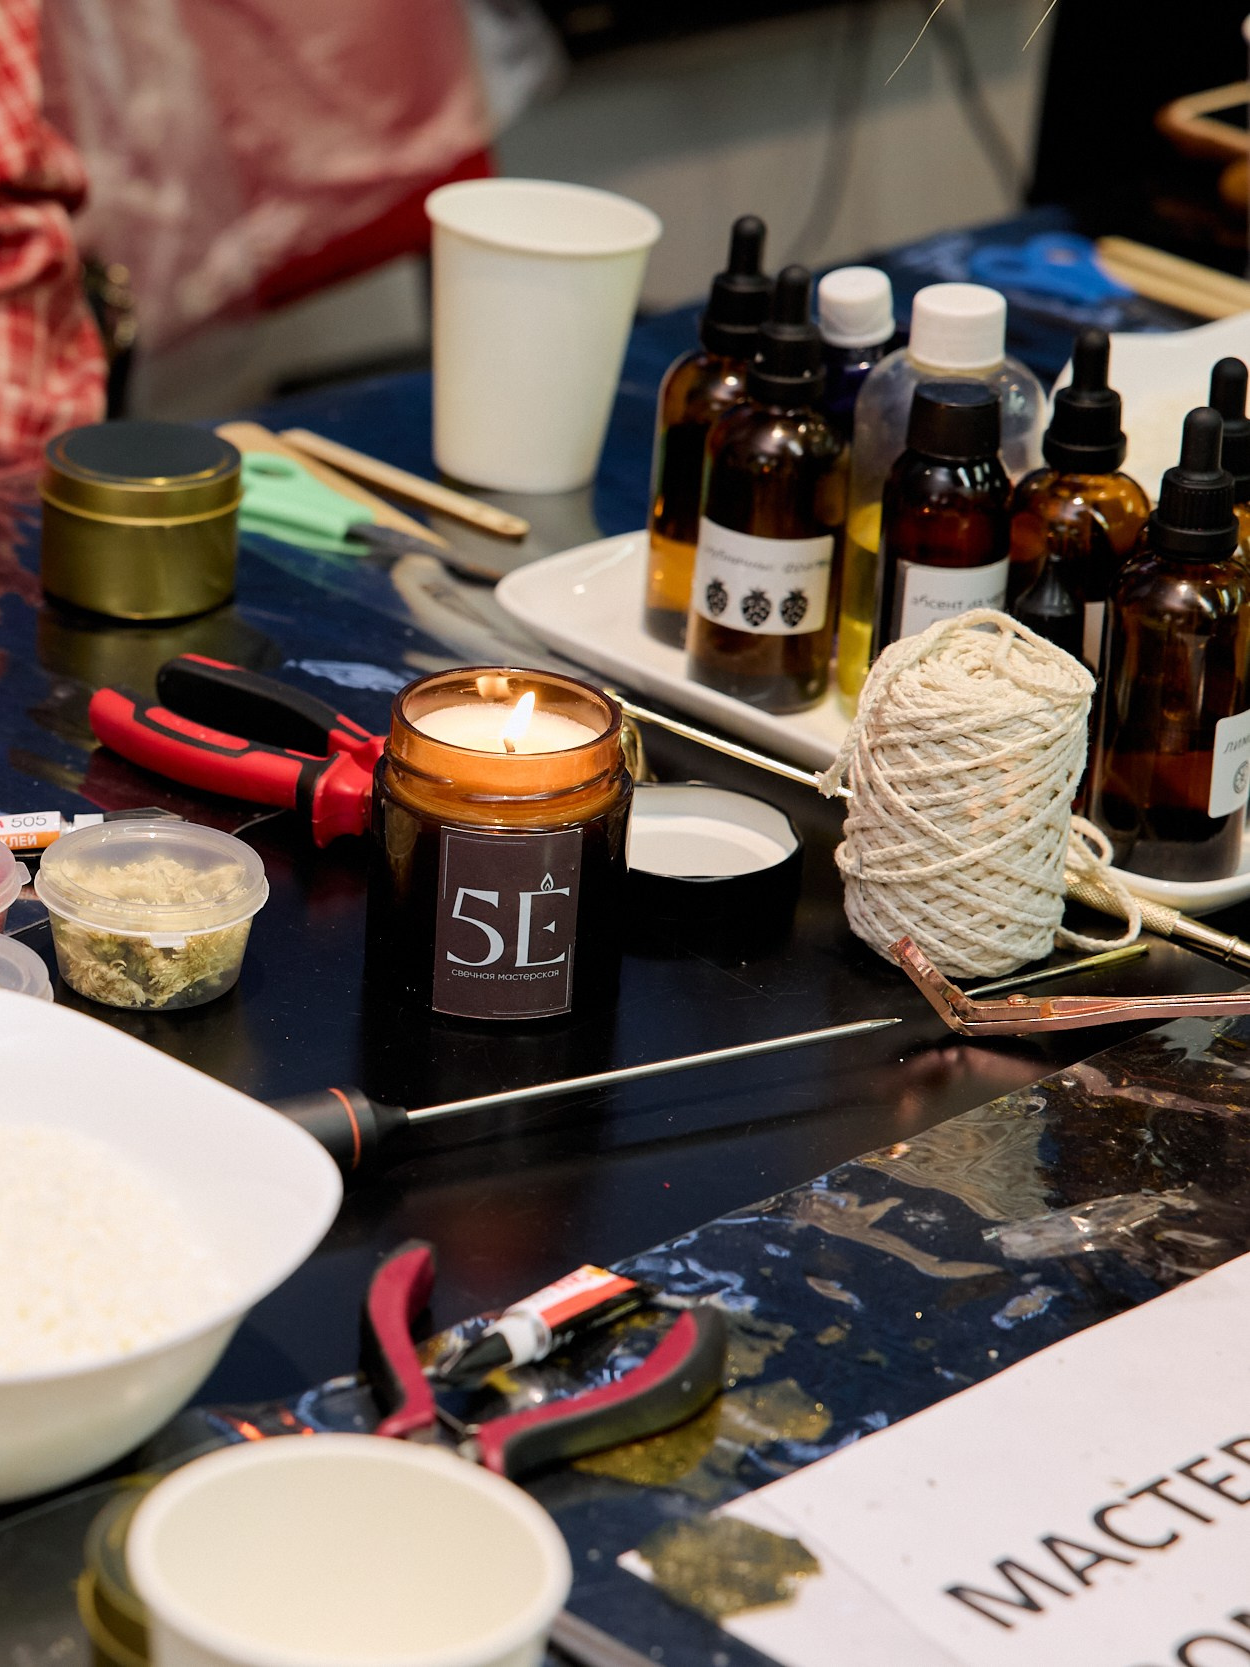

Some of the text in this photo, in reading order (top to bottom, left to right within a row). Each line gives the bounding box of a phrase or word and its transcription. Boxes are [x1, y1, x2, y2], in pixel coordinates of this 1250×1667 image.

[11, 815, 47, 829] 505
[451, 967, 560, 982] свечная мастерская
